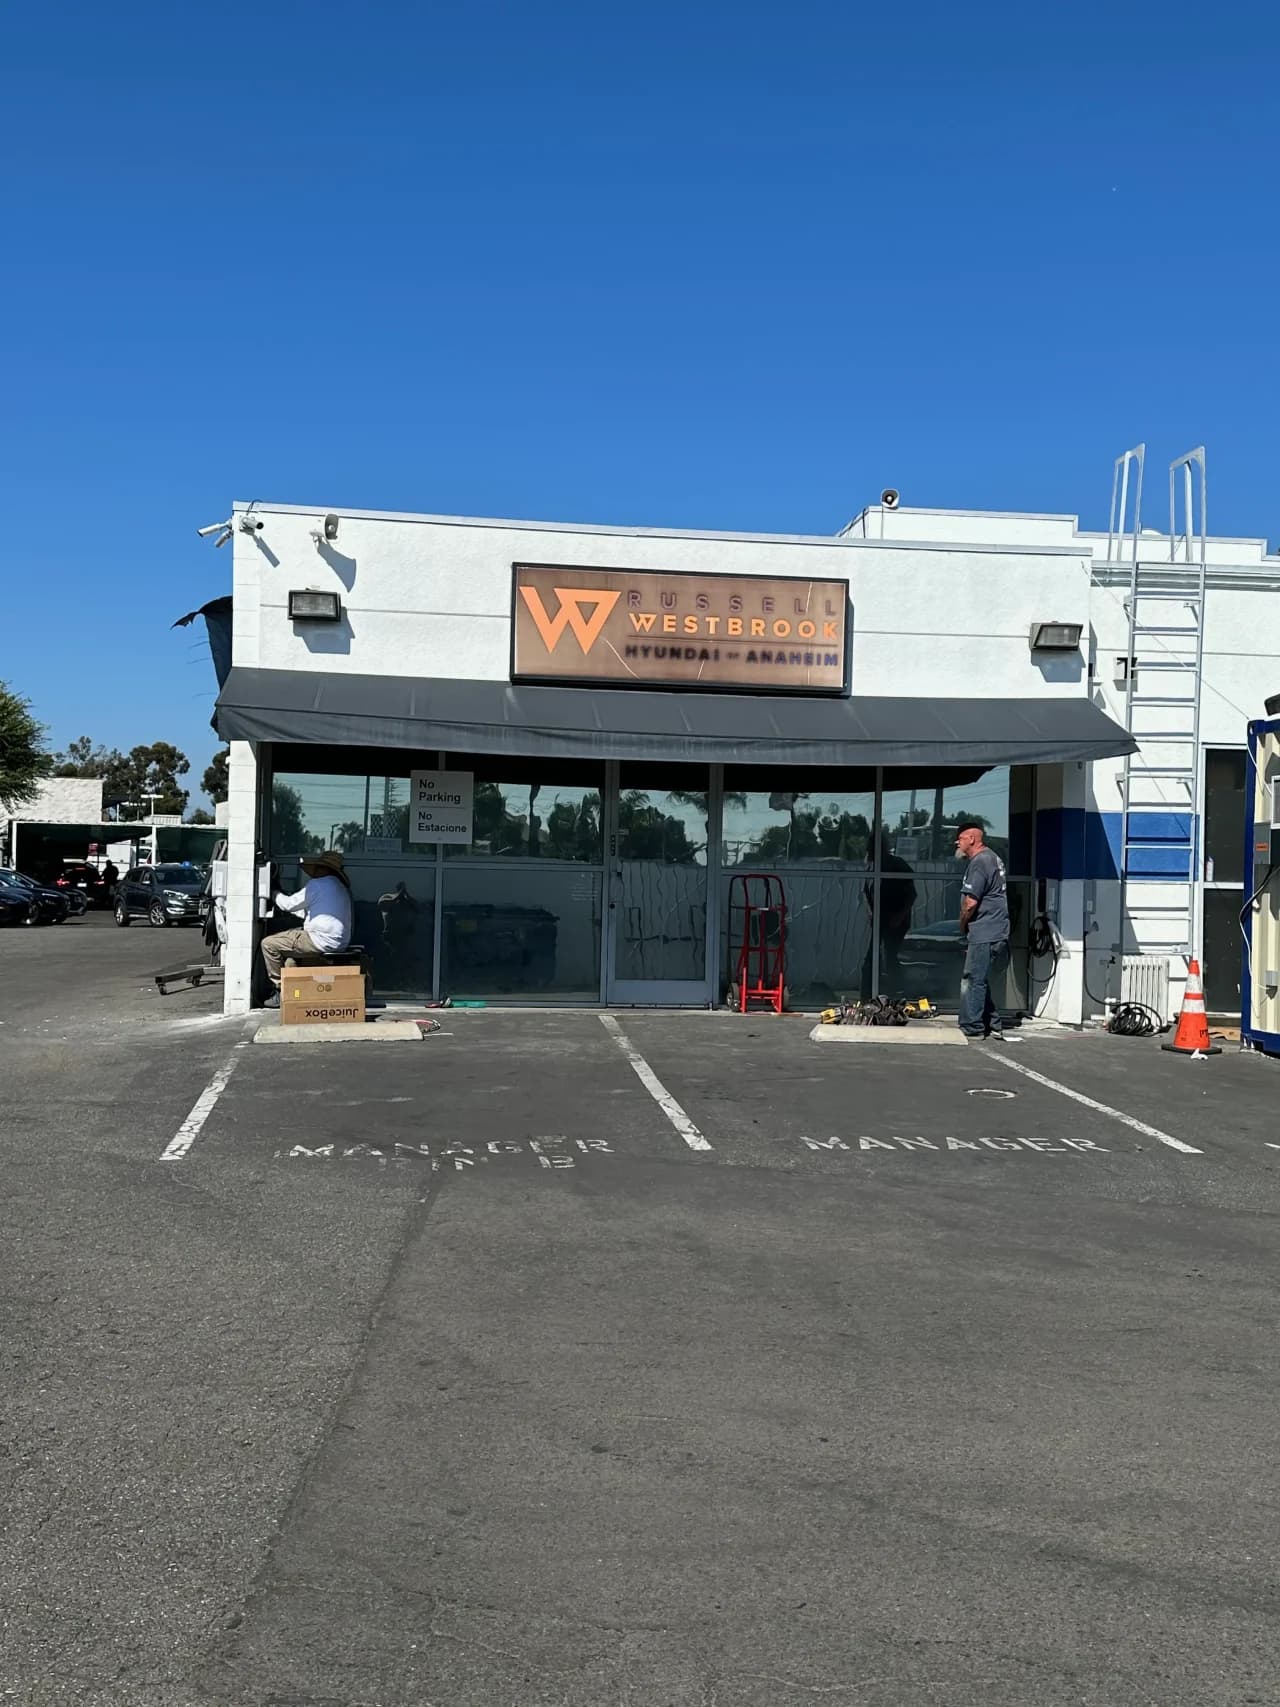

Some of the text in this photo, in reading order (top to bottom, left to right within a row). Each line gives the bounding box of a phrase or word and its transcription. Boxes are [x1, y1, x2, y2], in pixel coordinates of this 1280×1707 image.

[628, 589, 837, 616] RUSSELL
[628, 612, 838, 640] WESTBROOK
[625, 645, 719, 661] HYUNDAI
[746, 650, 838, 666] ANAHEIM
[419, 779, 435, 789] No
[419, 792, 461, 804] Parking
[418, 811, 433, 820] No
[418, 823, 467, 832] Estacione
[305, 1008, 359, 1019] JuiceBox
[800, 1136, 1112, 1153] MANAGER
